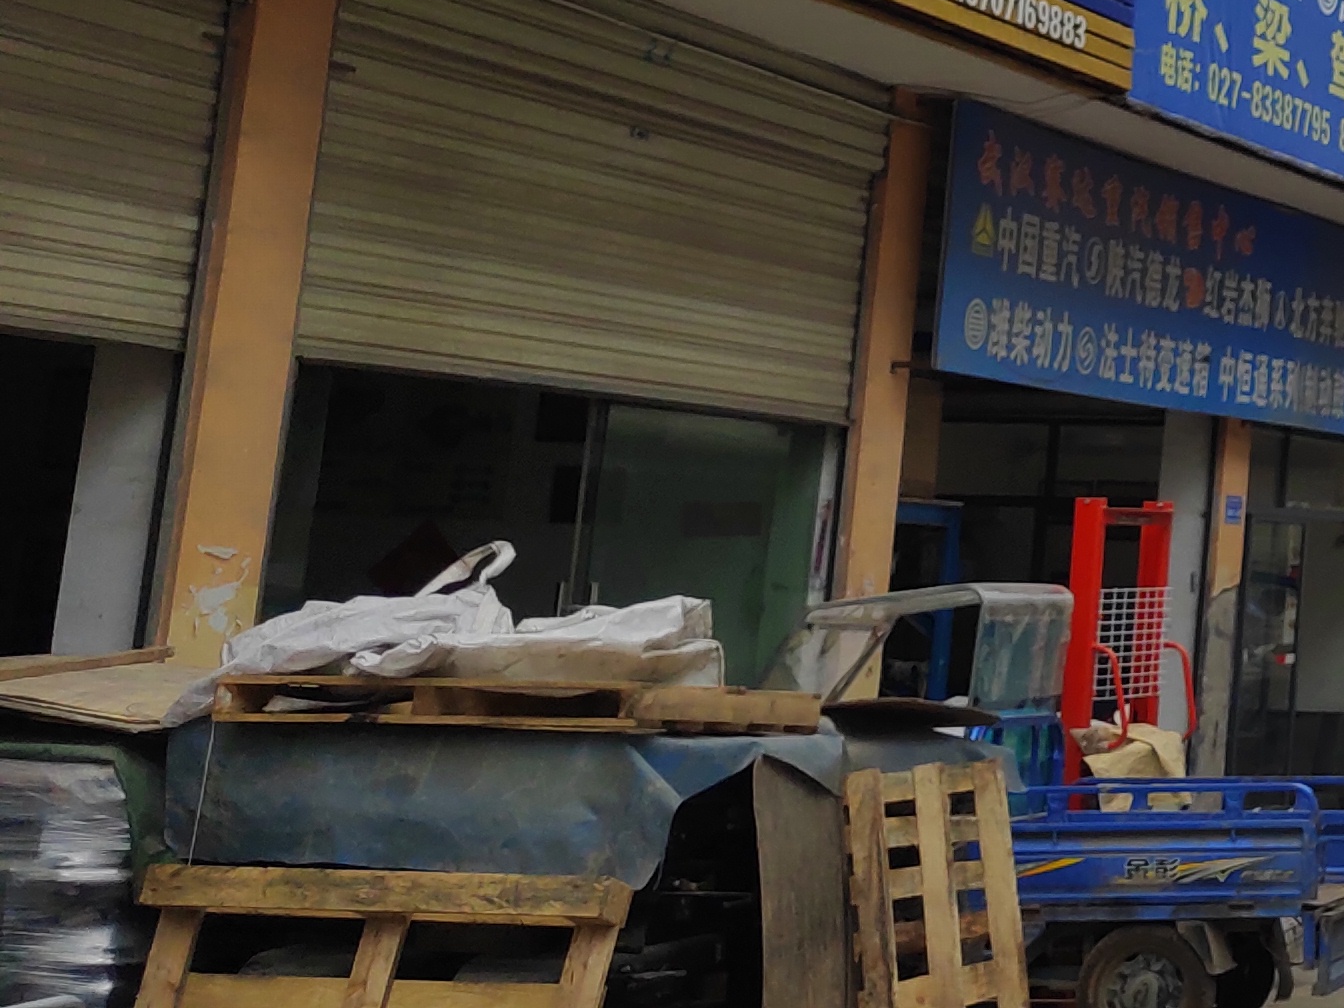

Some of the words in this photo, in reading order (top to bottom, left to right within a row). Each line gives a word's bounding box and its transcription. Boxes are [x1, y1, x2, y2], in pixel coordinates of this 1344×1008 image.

[997, 206, 1081, 289] 中国重汽
[1105, 239, 1182, 313] 陕汽德龙
[986, 297, 1074, 373] 潍柴动力
